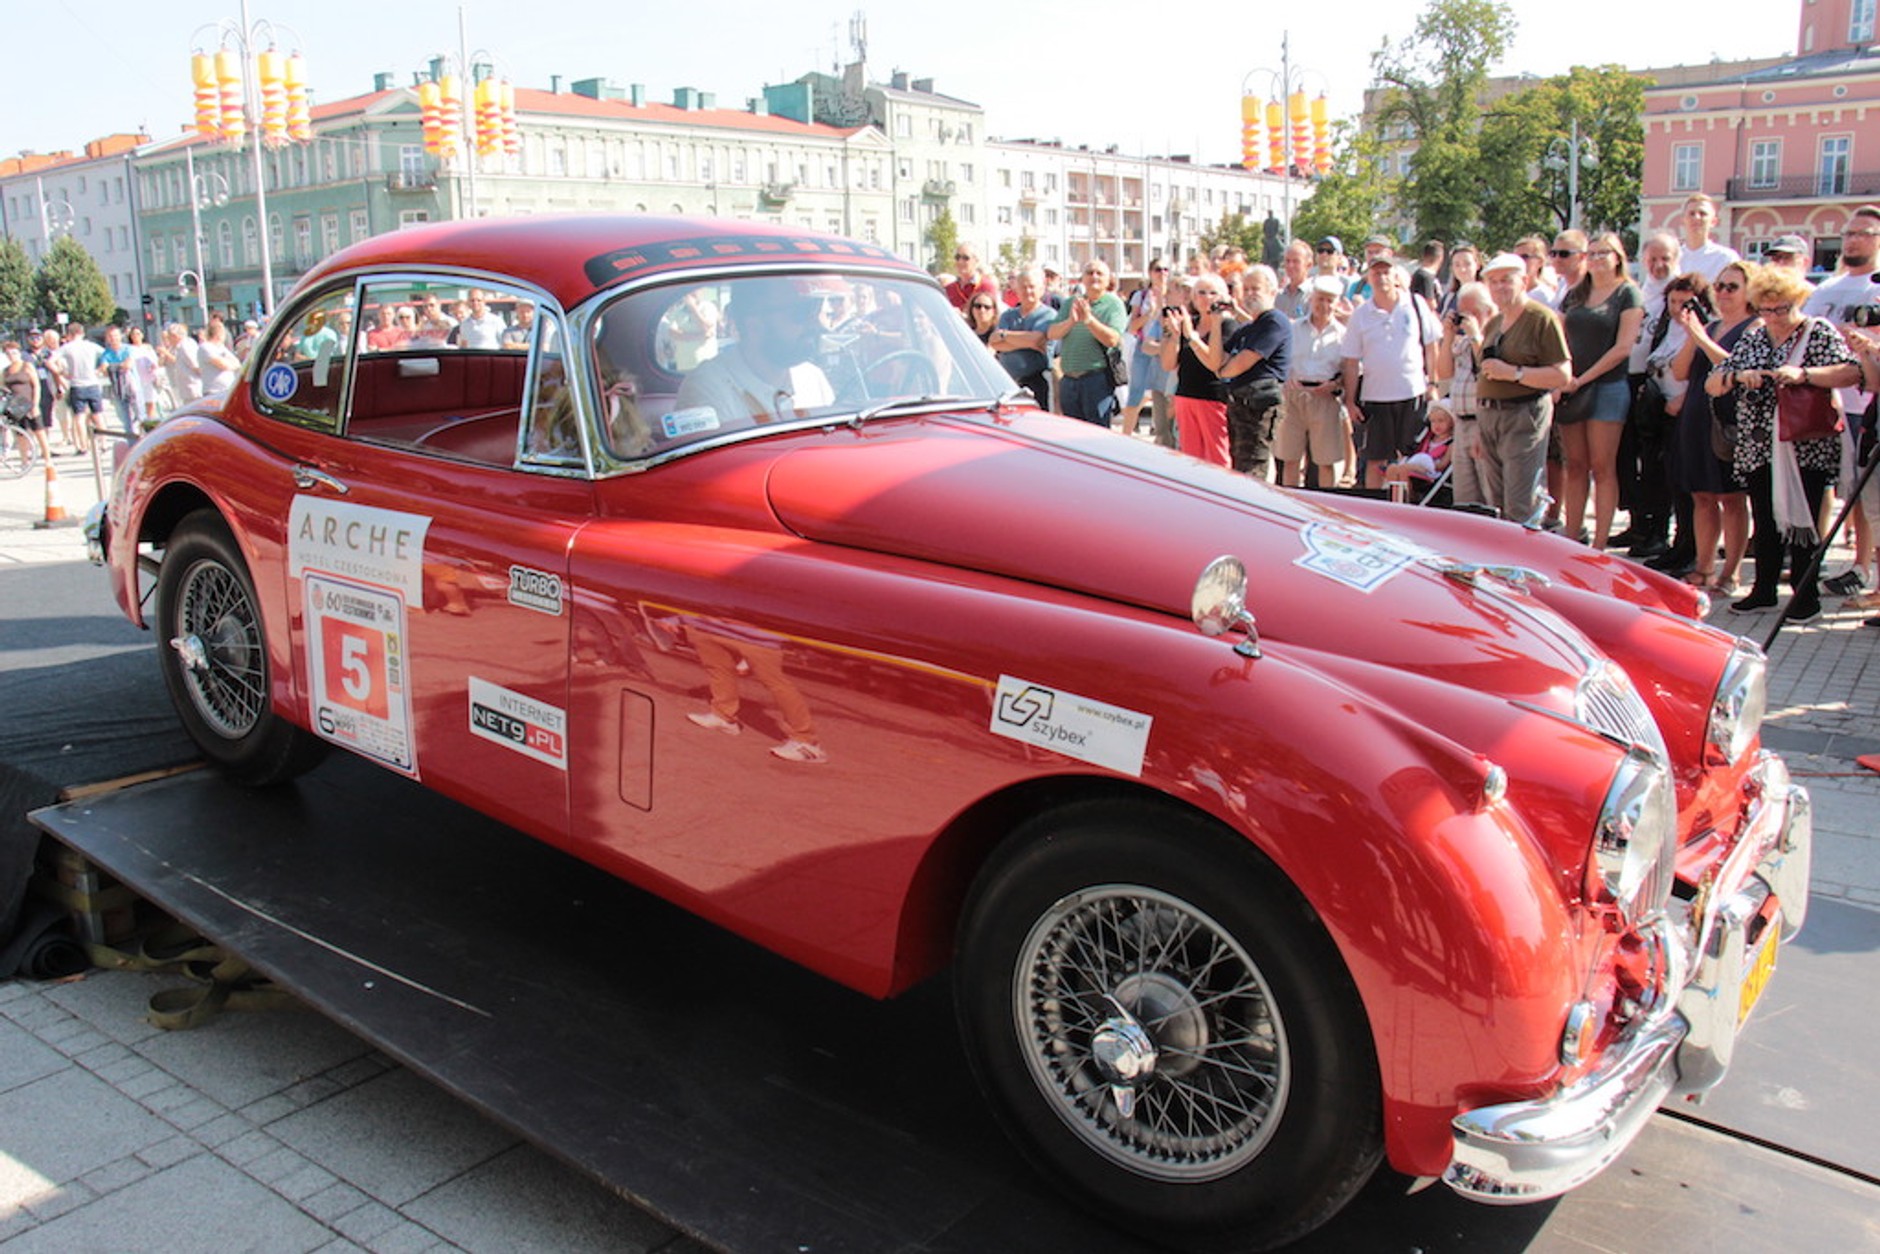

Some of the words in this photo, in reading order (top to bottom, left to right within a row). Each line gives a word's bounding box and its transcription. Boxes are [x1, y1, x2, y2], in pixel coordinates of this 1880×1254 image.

[300, 512, 411, 560] ARCHE
[299, 552, 331, 569] HOTEL
[511, 568, 560, 599] TURBO
[326, 591, 342, 612] 60
[341, 635, 372, 701] 5
[500, 694, 562, 729] INTERNET
[1077, 704, 1145, 730] www.szybex.pl
[1032, 721, 1087, 747] szybex
